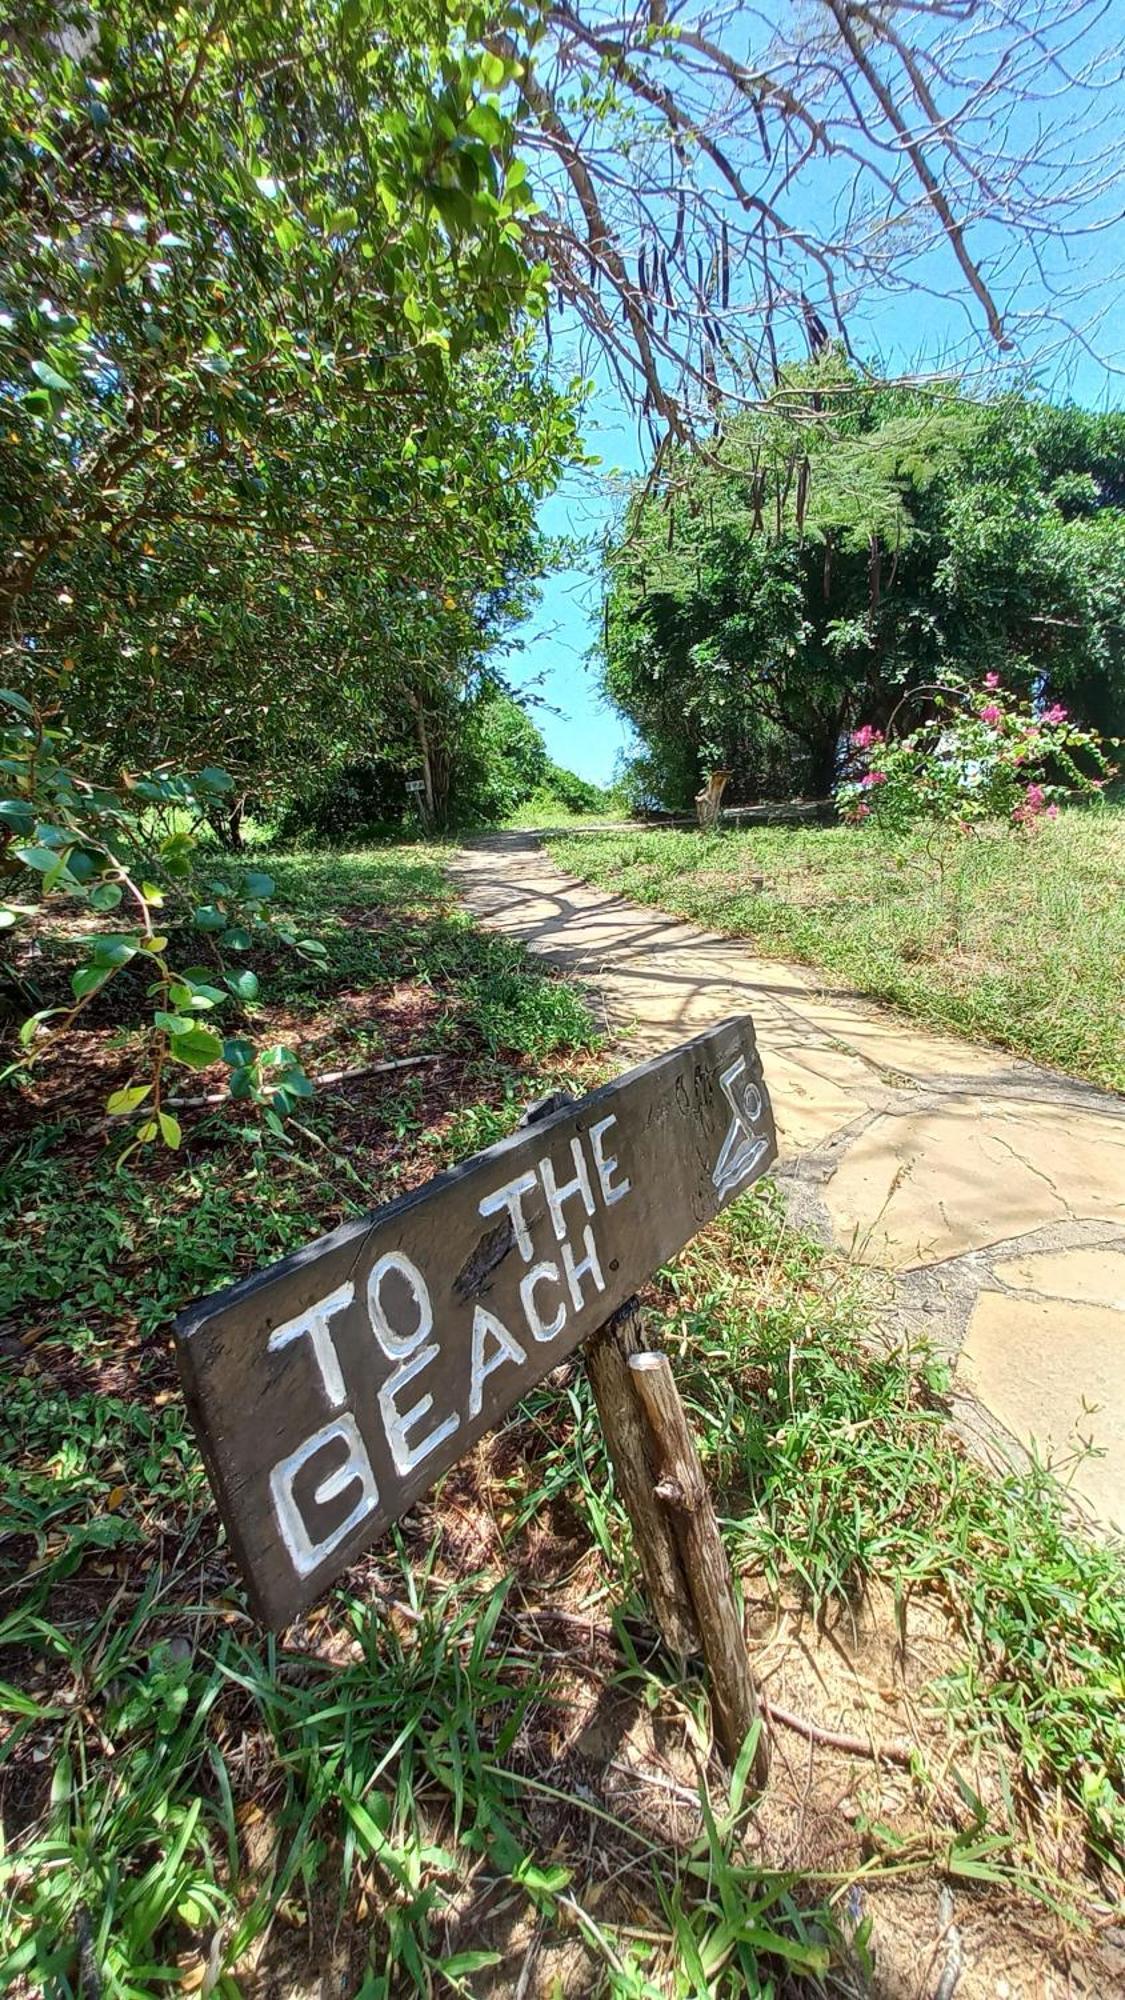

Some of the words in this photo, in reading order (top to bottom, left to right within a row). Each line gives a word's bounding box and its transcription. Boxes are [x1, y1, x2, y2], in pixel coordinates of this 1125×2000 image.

[268, 1251, 433, 1407] TO
[479, 1115, 631, 1262] THE
[269, 1226, 605, 1574] BEACH
